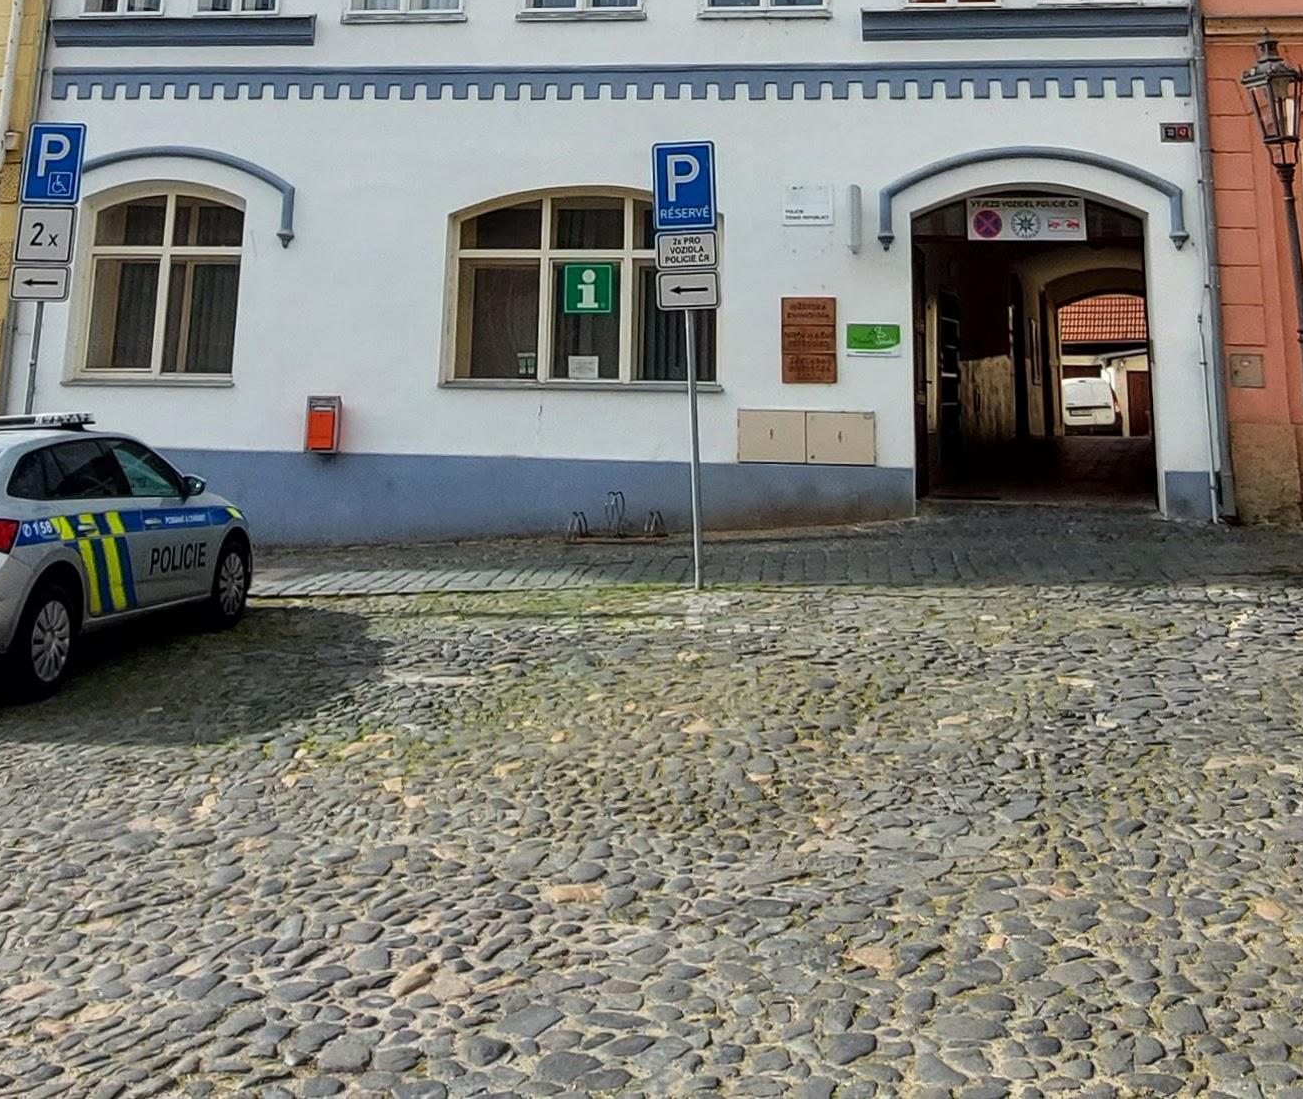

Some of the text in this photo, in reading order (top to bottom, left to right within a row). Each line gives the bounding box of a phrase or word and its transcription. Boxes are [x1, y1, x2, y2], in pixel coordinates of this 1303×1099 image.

[37, 133, 71, 177] P
[667, 154, 700, 202] P
[660, 205, 710, 219] RÉSERVÉ
[30, 222, 58, 247] 2x
[683, 236, 701, 245] PRO
[665, 253, 710, 264] POLICIE ČR
[670, 245, 704, 254] VOZIDLA
[149, 543, 207, 575] POLICIE
